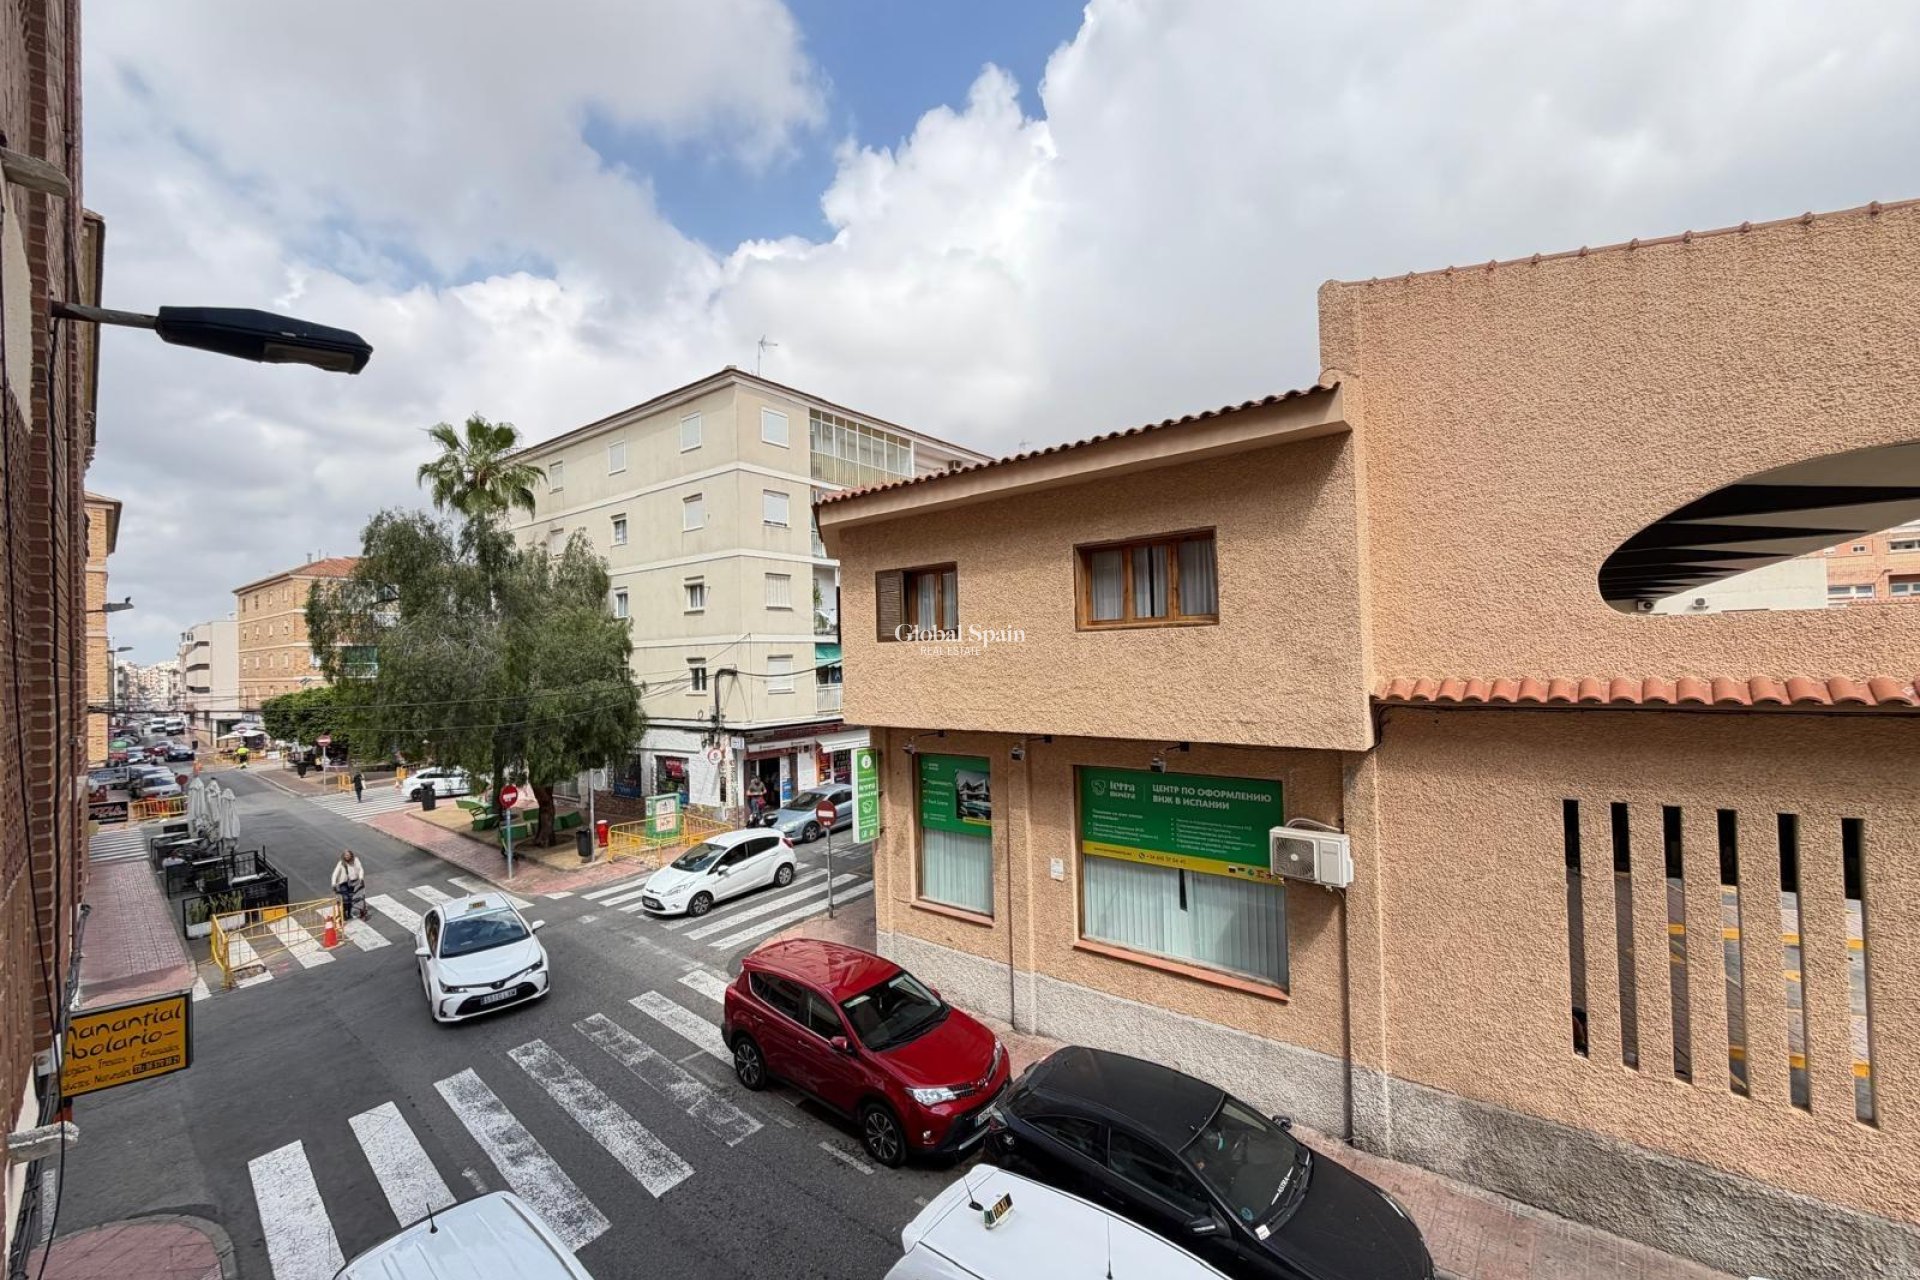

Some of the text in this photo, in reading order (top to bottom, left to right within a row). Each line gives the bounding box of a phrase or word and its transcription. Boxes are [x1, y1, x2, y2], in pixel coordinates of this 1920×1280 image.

[1152, 784, 1272, 803] ЦЕНТР ПО ОФОРМЛЕНИЮ
[1175, 797, 1181, 805] В
[1182, 797, 1230, 810] ИСПАНИИ
